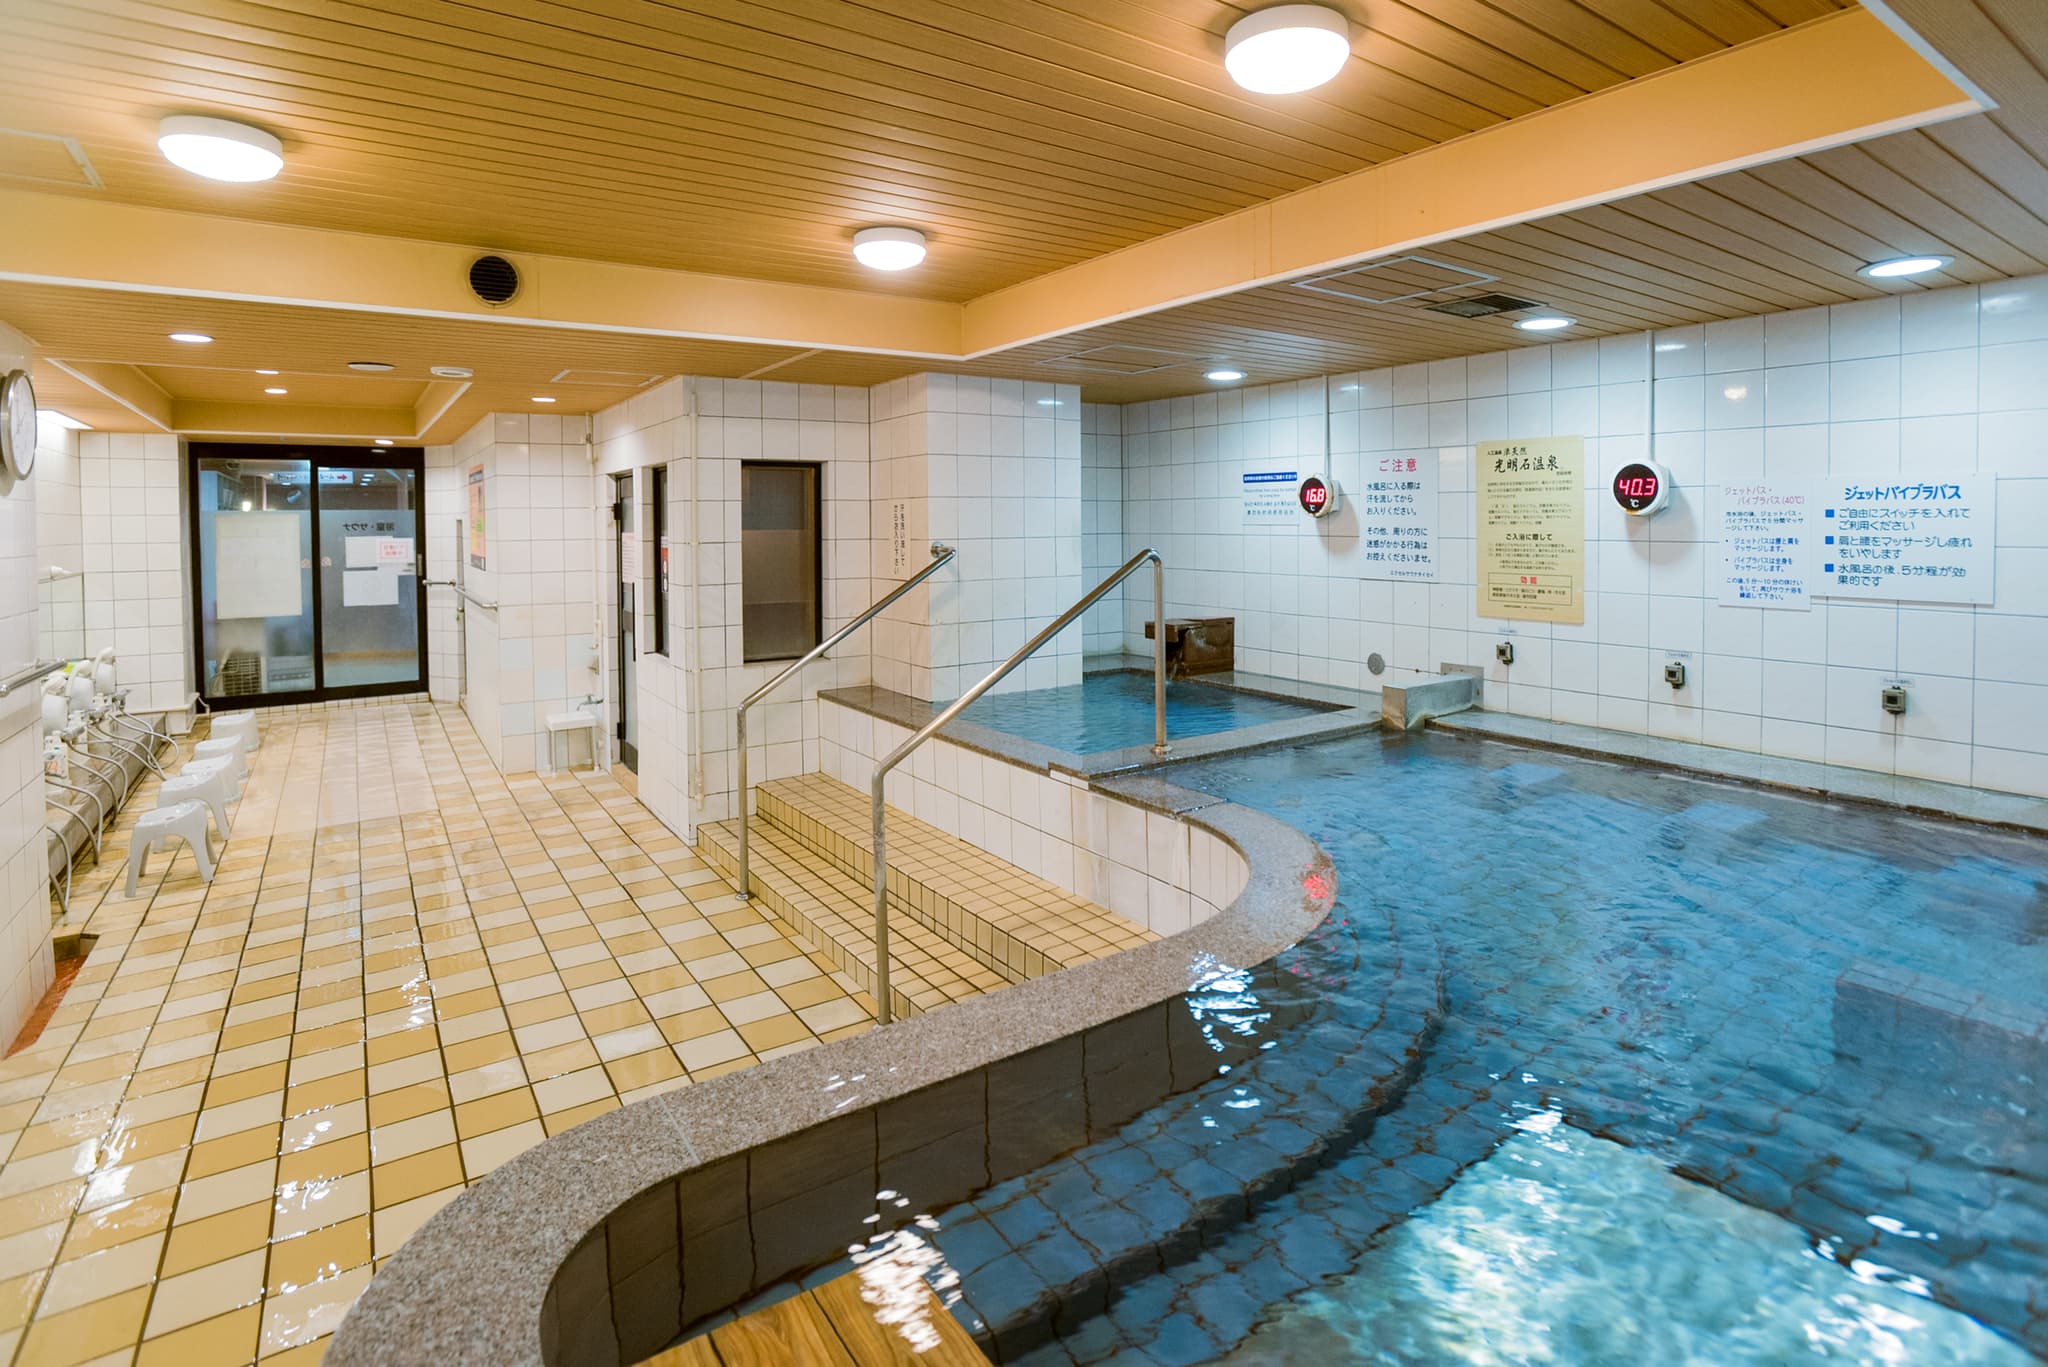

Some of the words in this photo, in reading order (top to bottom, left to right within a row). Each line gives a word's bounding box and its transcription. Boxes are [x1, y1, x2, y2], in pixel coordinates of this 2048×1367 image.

[1379, 458, 1417, 473] ご注意
[1494, 455, 1559, 473] 光明石温泉
[1618, 477, 1656, 496] 40.3
[1844, 483, 1962, 500] ジェットバイブラバス
[1366, 494, 1414, 504] 汗を流してから
[1366, 506, 1417, 516] お入りください。
[1839, 507, 1971, 519] ご自由にスイッチを入れて
[1838, 520, 1915, 531] ご利用ください
[1366, 539, 1428, 550] 迷惑がかかる行為は
[1838, 535, 1973, 548] 肩と腰をマッサージし疲れ
[1366, 552, 1431, 564] お控えくださいませ。
[1839, 549, 1902, 559] をいやします
[1837, 575, 1883, 587] 果的です
